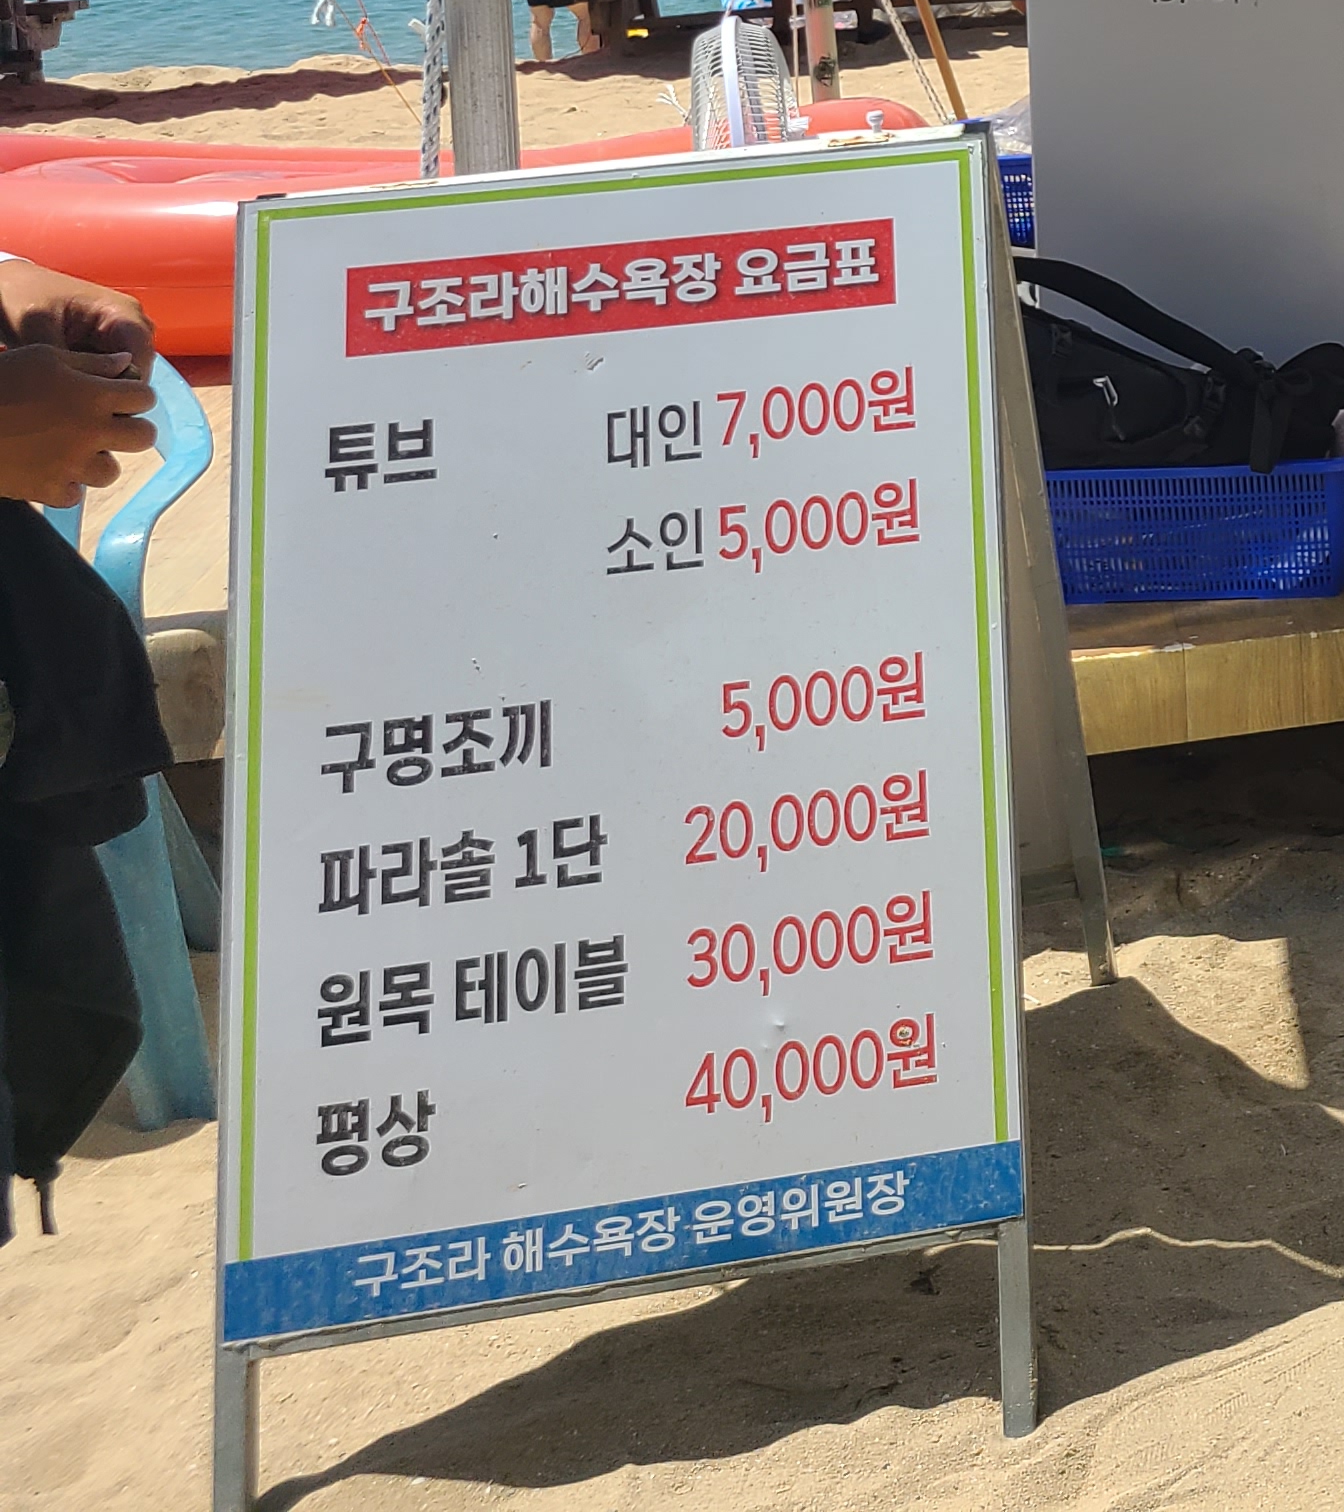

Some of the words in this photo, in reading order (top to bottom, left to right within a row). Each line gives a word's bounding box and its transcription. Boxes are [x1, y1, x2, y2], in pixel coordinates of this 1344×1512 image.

[364, 253, 723, 333] 구조라해수욕장
[731, 236, 881, 298] 요금표
[323, 418, 440, 494] 튜브
[606, 399, 705, 469] 대인
[716, 365, 917, 459] 7,000원
[605, 506, 705, 576] 소인
[717, 478, 922, 574] 5,000원
[319, 698, 554, 796] 구명조끼
[720, 651, 927, 754] 5,000원
[317, 828, 496, 916] 파라솔
[513, 814, 609, 888] 1단
[683, 769, 931, 874] 20,000원
[316, 960, 436, 1049] 원목
[453, 933, 629, 1026] 테이블
[686, 890, 934, 998] 30,000원
[314, 1090, 437, 1178] 평상
[683, 1012, 938, 1125] 40,000원
[354, 1235, 491, 1298] 구조라
[503, 1207, 683, 1277] 해수욕장
[691, 1171, 910, 1245] 운영위원장
